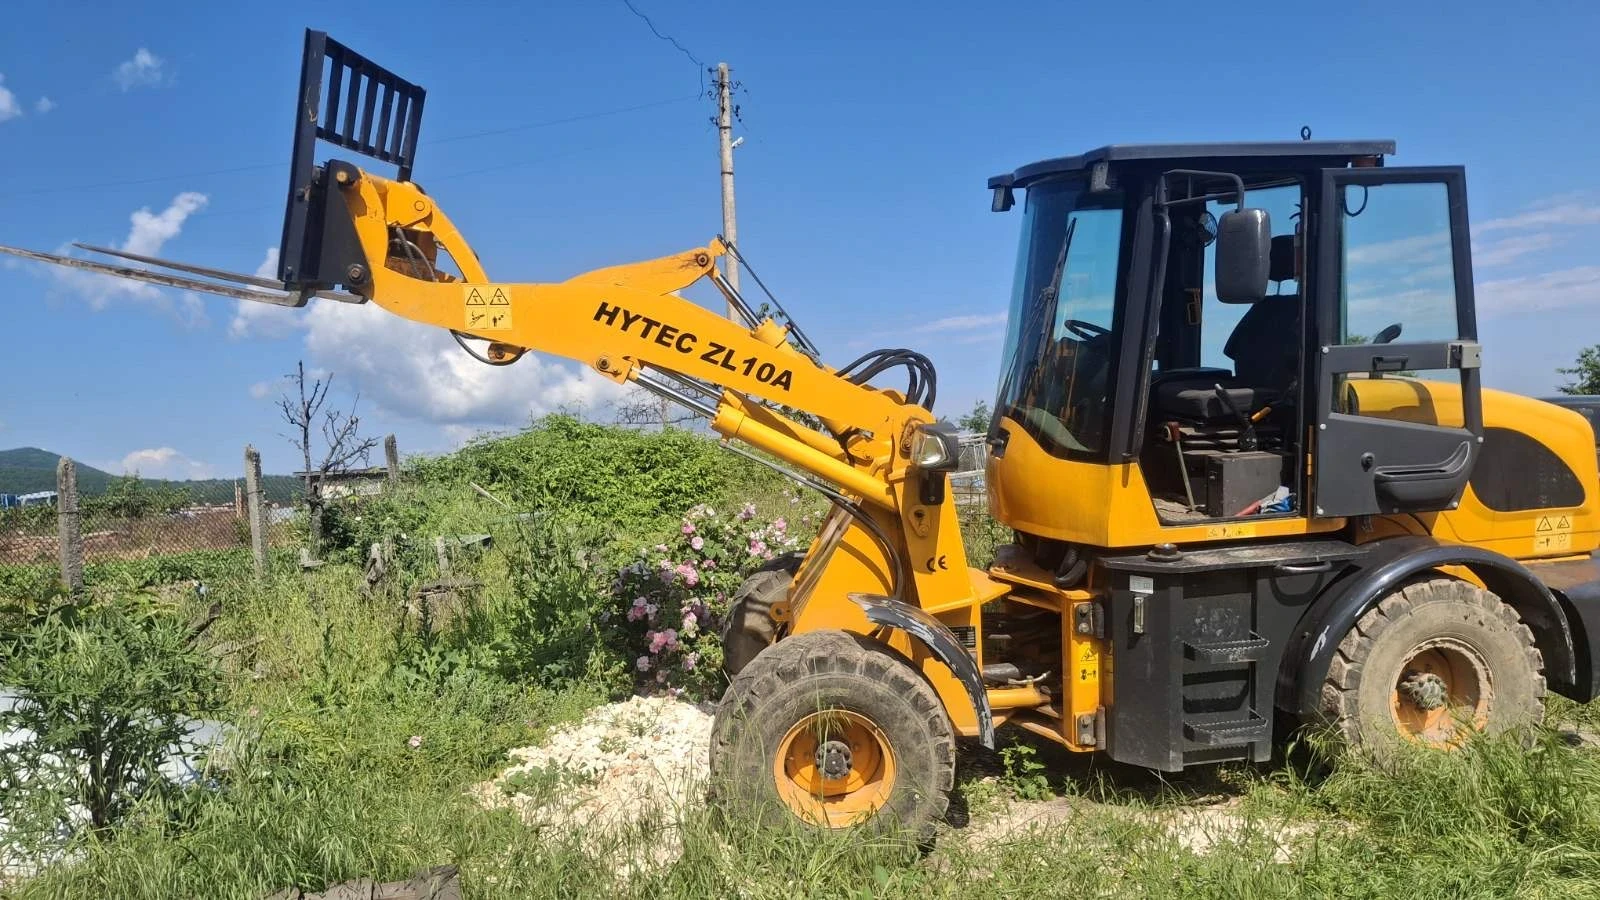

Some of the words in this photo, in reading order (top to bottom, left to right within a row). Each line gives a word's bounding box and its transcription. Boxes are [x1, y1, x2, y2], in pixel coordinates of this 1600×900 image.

[593, 302, 697, 354] HYTEC
[700, 342, 793, 391] ZL10A
[926, 555, 948, 572] CE
